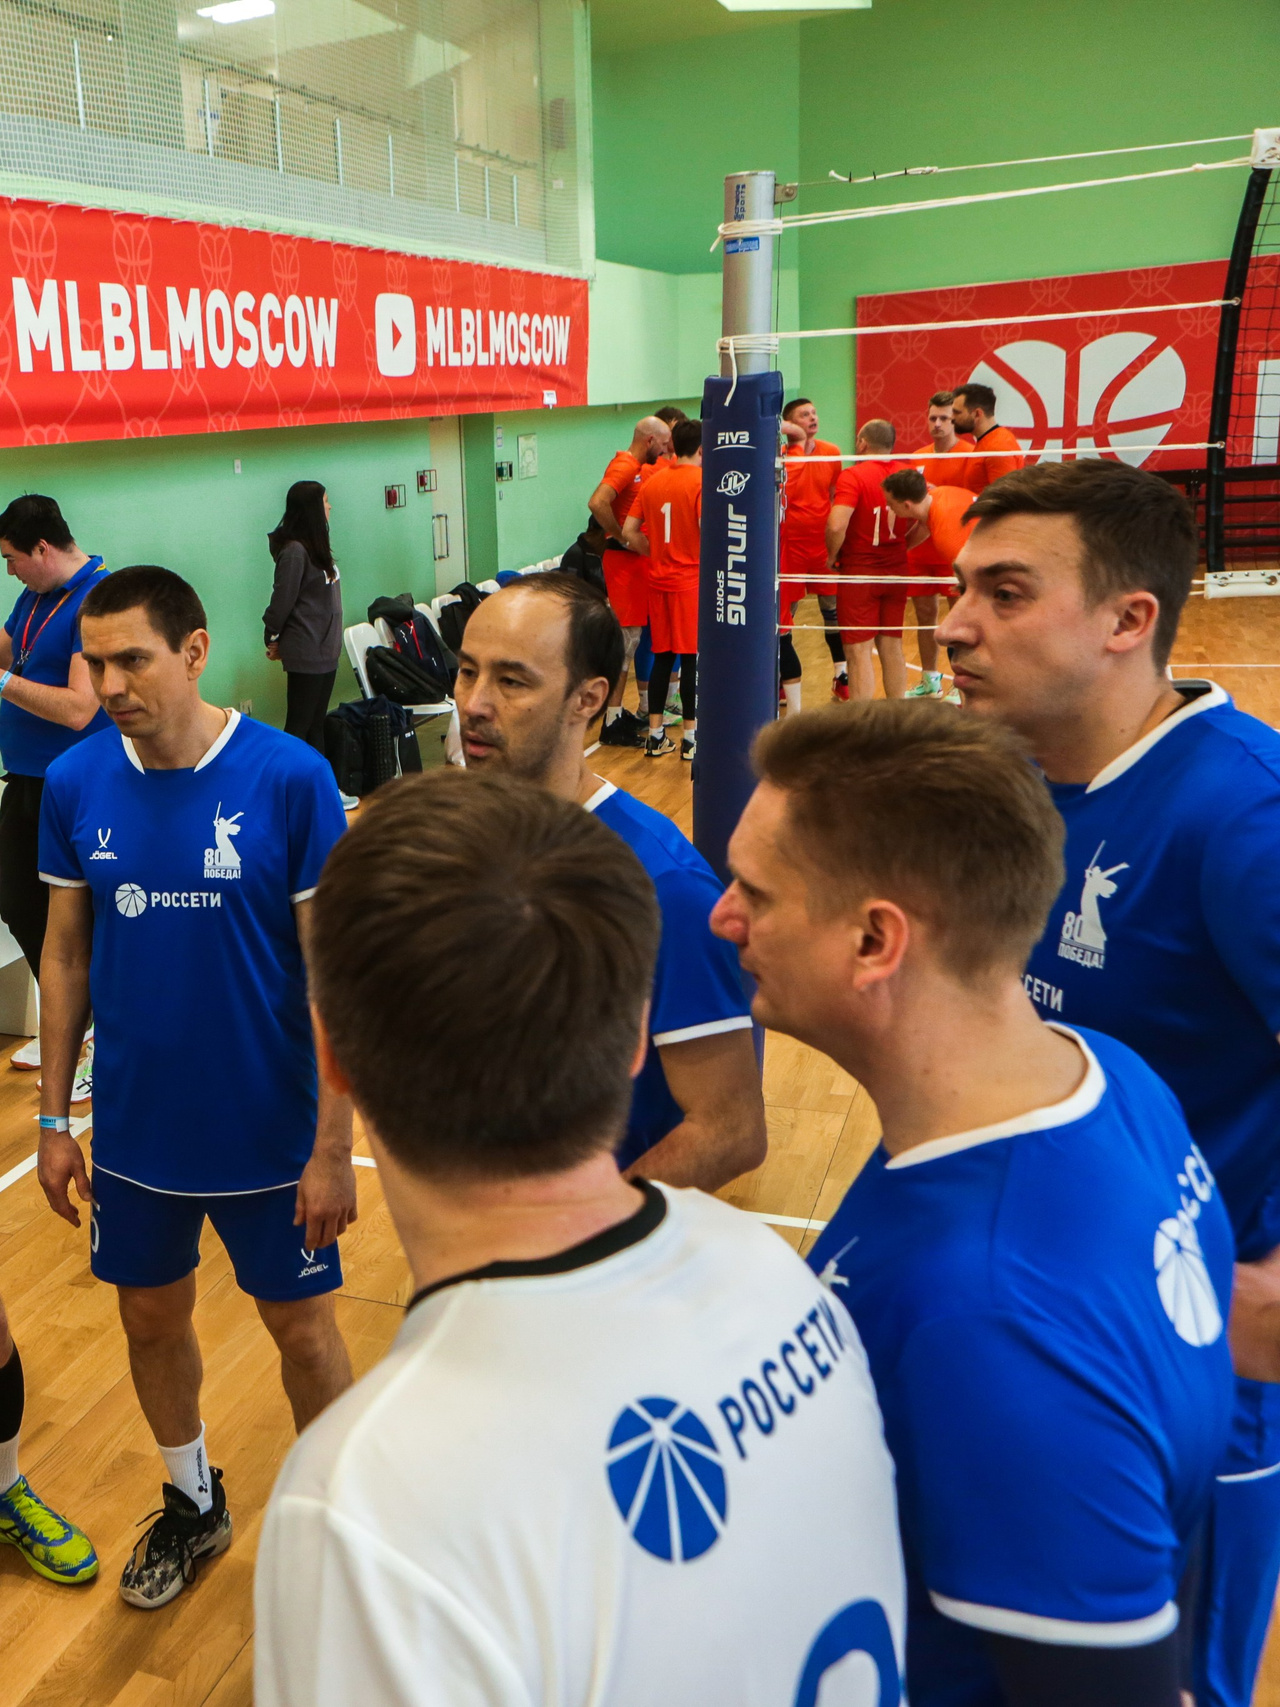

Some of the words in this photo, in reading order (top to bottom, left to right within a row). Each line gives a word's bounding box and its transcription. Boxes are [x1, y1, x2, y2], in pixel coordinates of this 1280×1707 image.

[12, 277, 338, 372] MLBLMOSCOW
[426, 305, 570, 367] MLBLMOSCOW
[660, 502, 671, 543] 1
[716, 570, 724, 623] SPORTS
[89, 850, 118, 860] JÖGEL
[204, 869, 241, 880] ПОБЕДА!
[151, 892, 222, 908] РОССЕТИ
[1057, 942, 1105, 969] ПОБЕДА!
[1022, 973, 1064, 1012] СЕТИ
